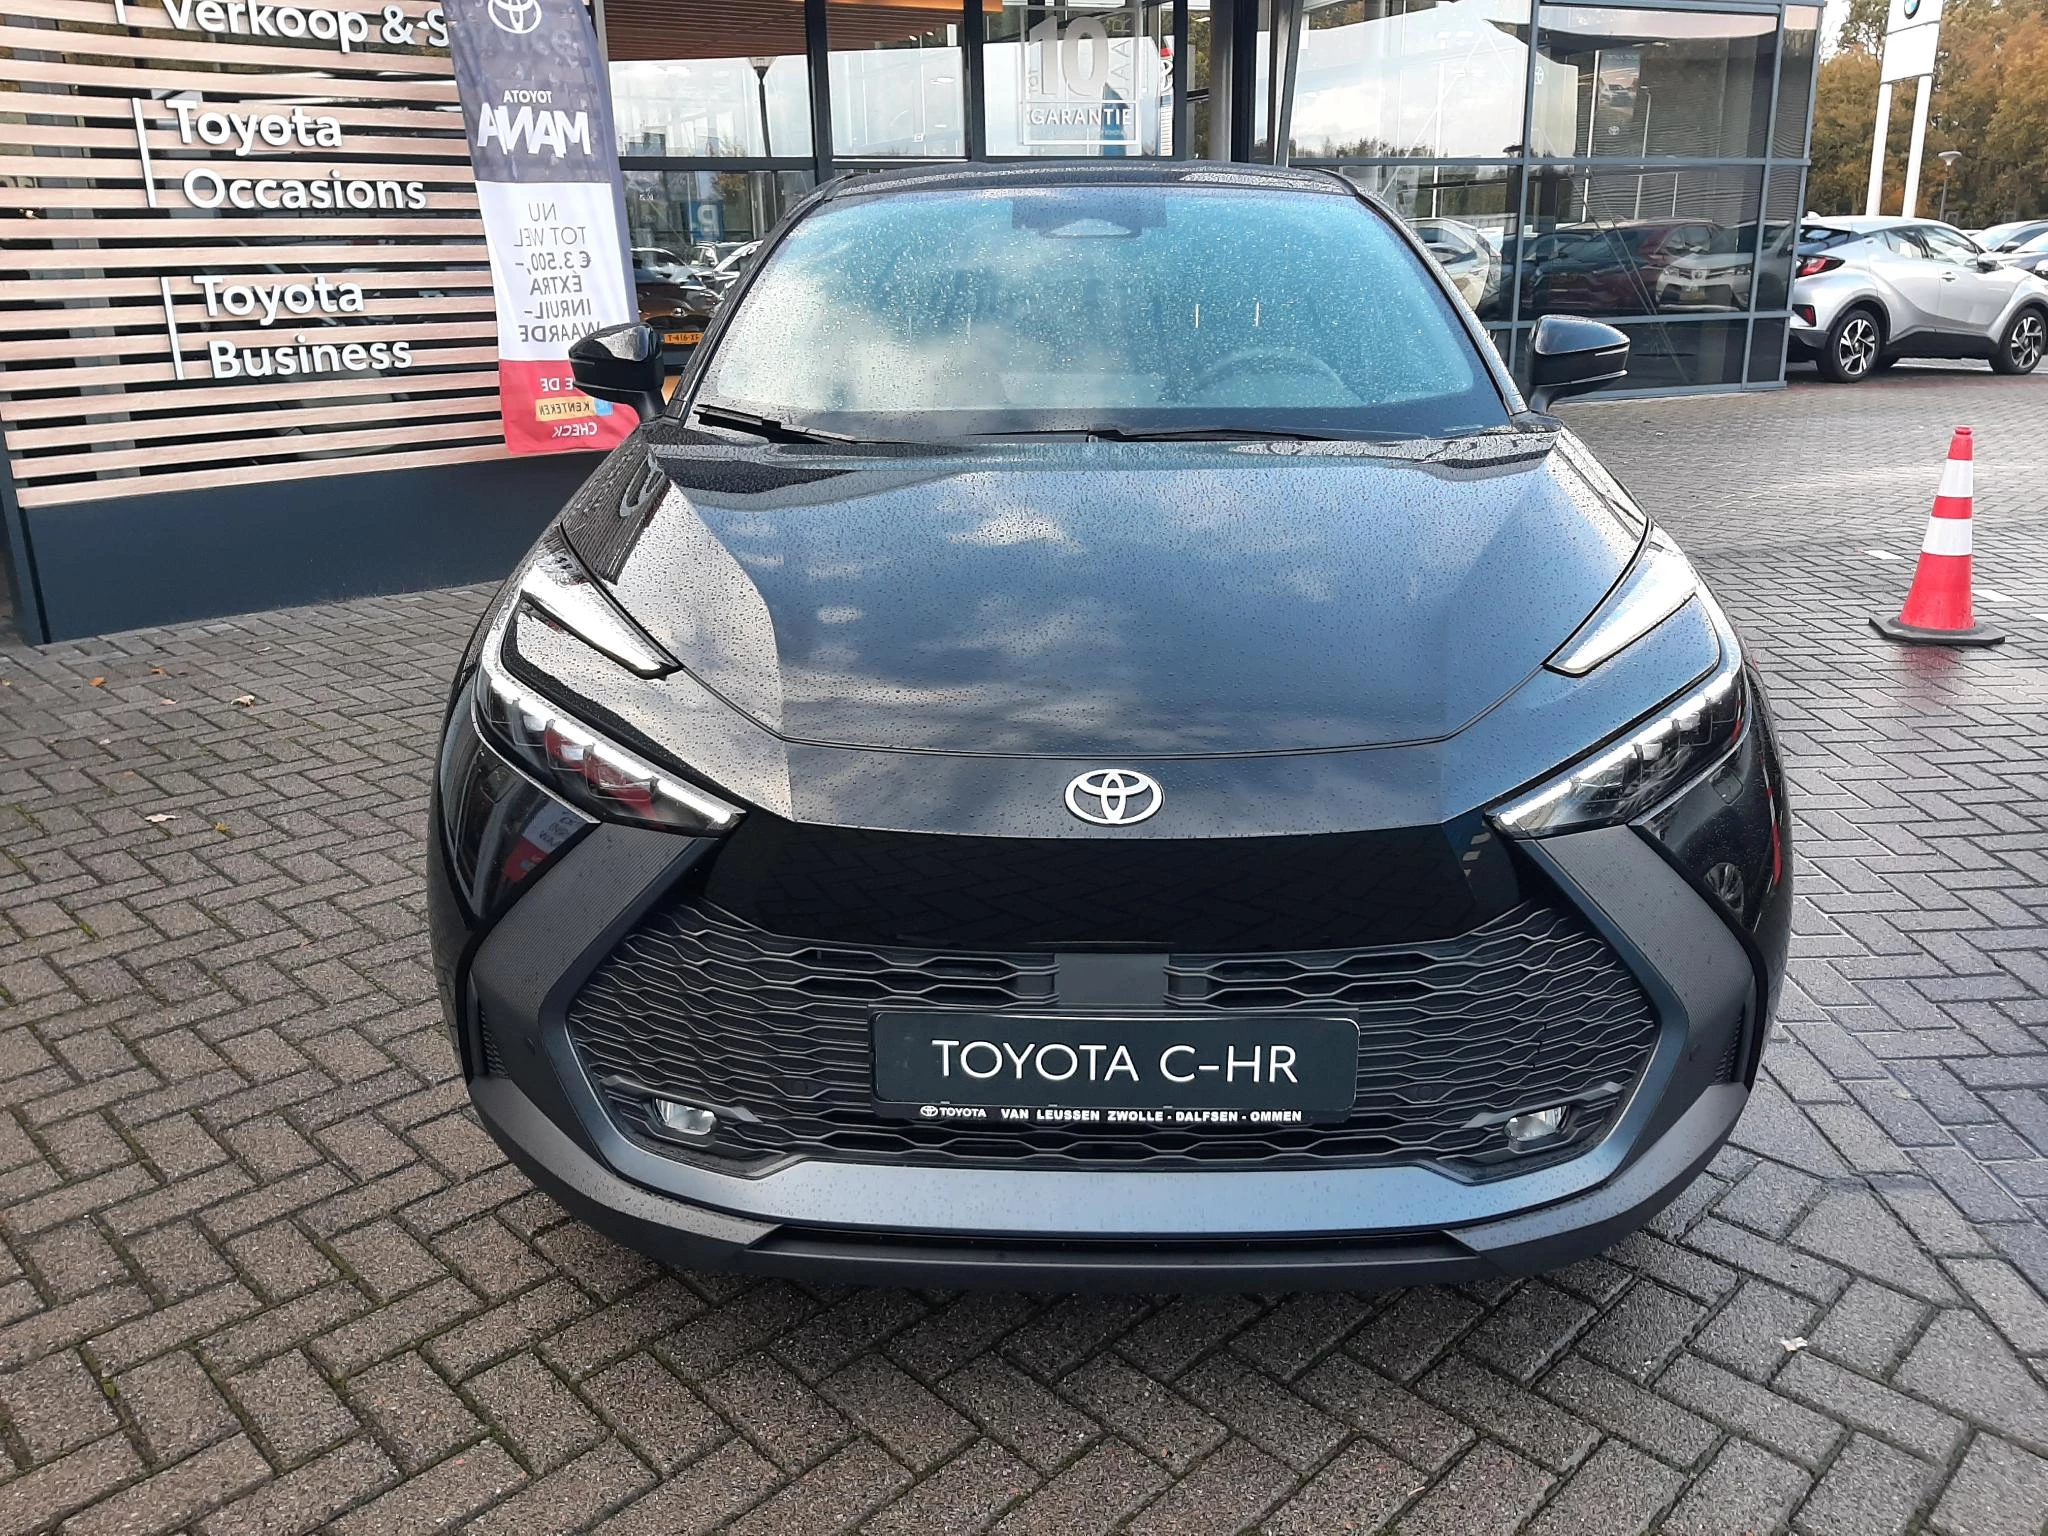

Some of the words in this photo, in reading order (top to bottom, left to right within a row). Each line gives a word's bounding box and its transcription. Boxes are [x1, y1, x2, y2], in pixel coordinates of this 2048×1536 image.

[163, 0, 369, 54] Verkoop
[382, 5, 416, 44] &
[1029, 15, 1110, 96] 10
[165, 99, 344, 156] Toyota
[1029, 108, 1132, 126] GARANTIE
[183, 167, 428, 210] Occasions
[192, 274, 365, 326] Toyota
[207, 334, 414, 380] Business
[931, 1039, 1140, 1083] TOYOTA
[1159, 1044, 1299, 1084] C-HR
[939, 1107, 987, 1118] TOYOTA
[1000, 1108, 1029, 1120] VAN
[1036, 1109, 1100, 1121] LEUSSEN
[1107, 1110, 1164, 1122] ZWOLLE
[1175, 1110, 1239, 1122] DALFSEN
[1250, 1110, 1302, 1122] OMMEN
